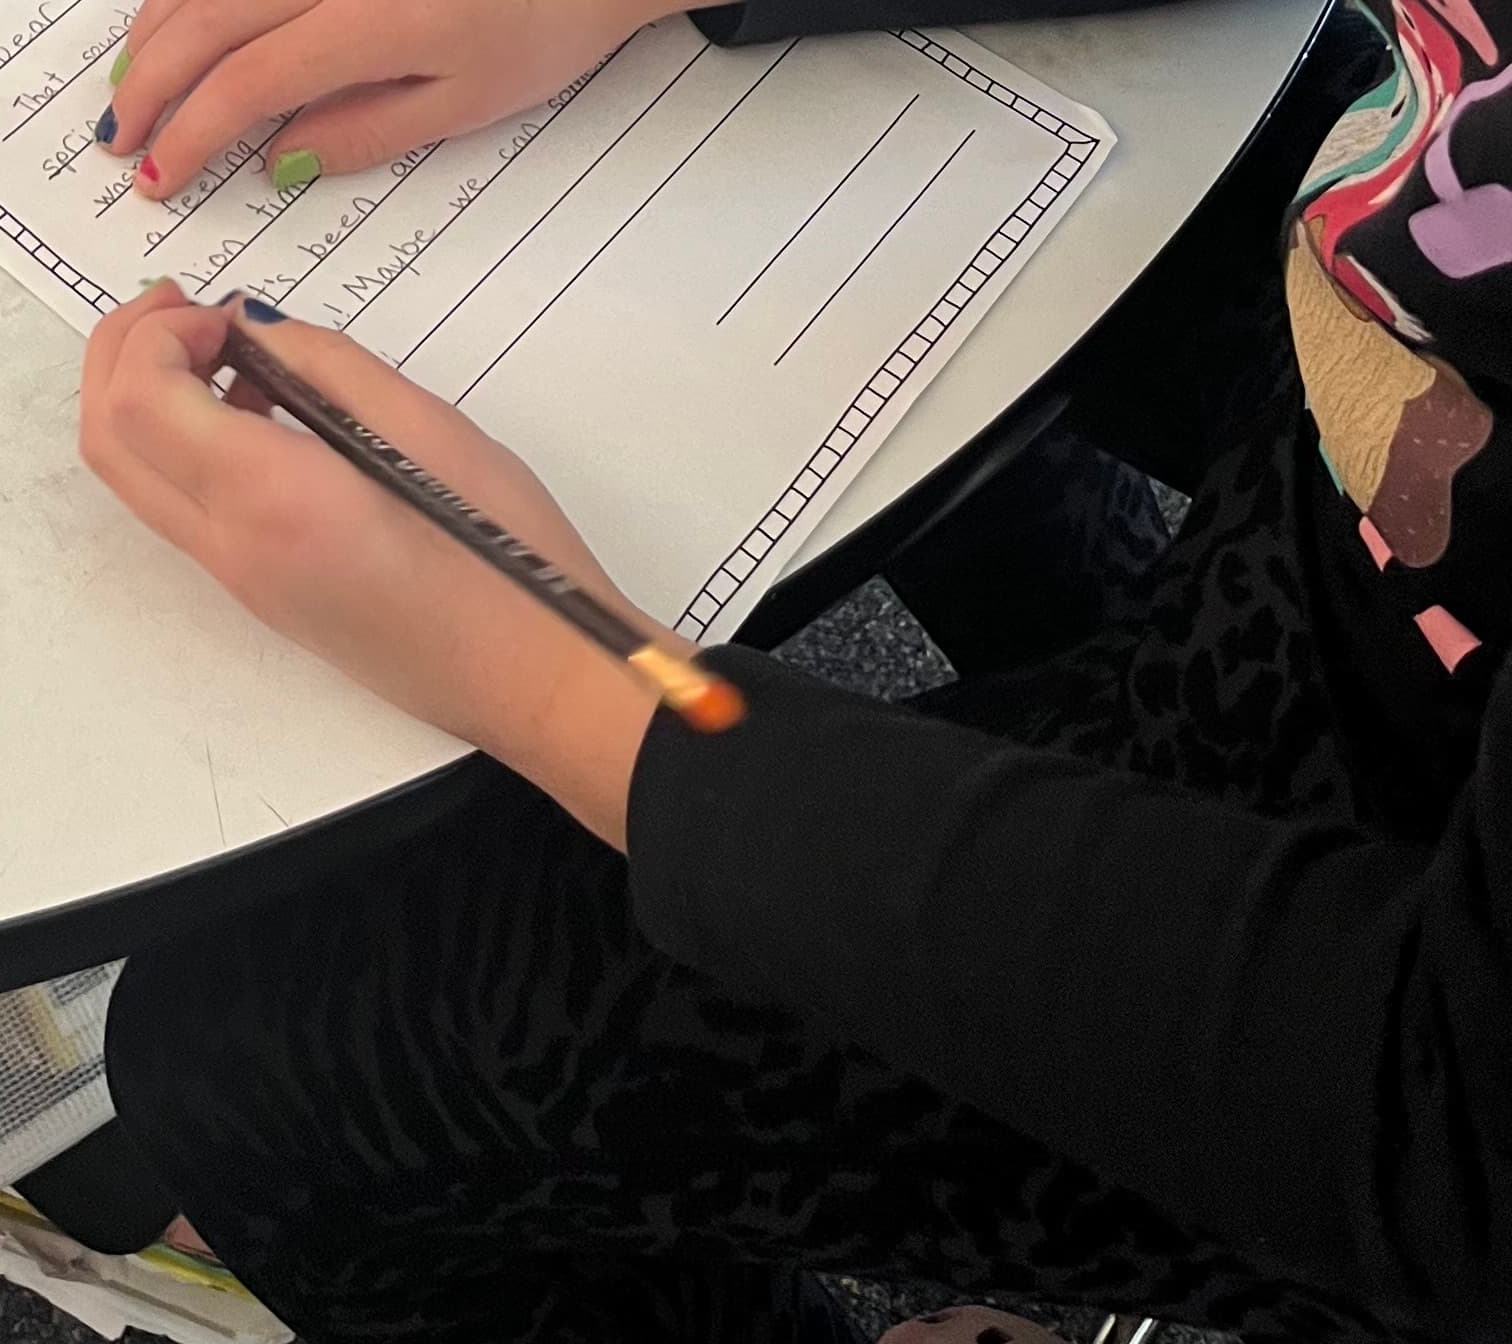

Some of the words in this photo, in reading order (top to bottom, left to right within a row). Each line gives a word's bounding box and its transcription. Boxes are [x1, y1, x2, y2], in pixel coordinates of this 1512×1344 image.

[12, 71, 64, 110] That
[163, 140, 267, 216] feeling
[300, 197, 375, 259] been
[343, 230, 435, 301] Maybe
[448, 178, 479, 208] we
[498, 122, 539, 159] can
[180, 239, 244, 283] lion
